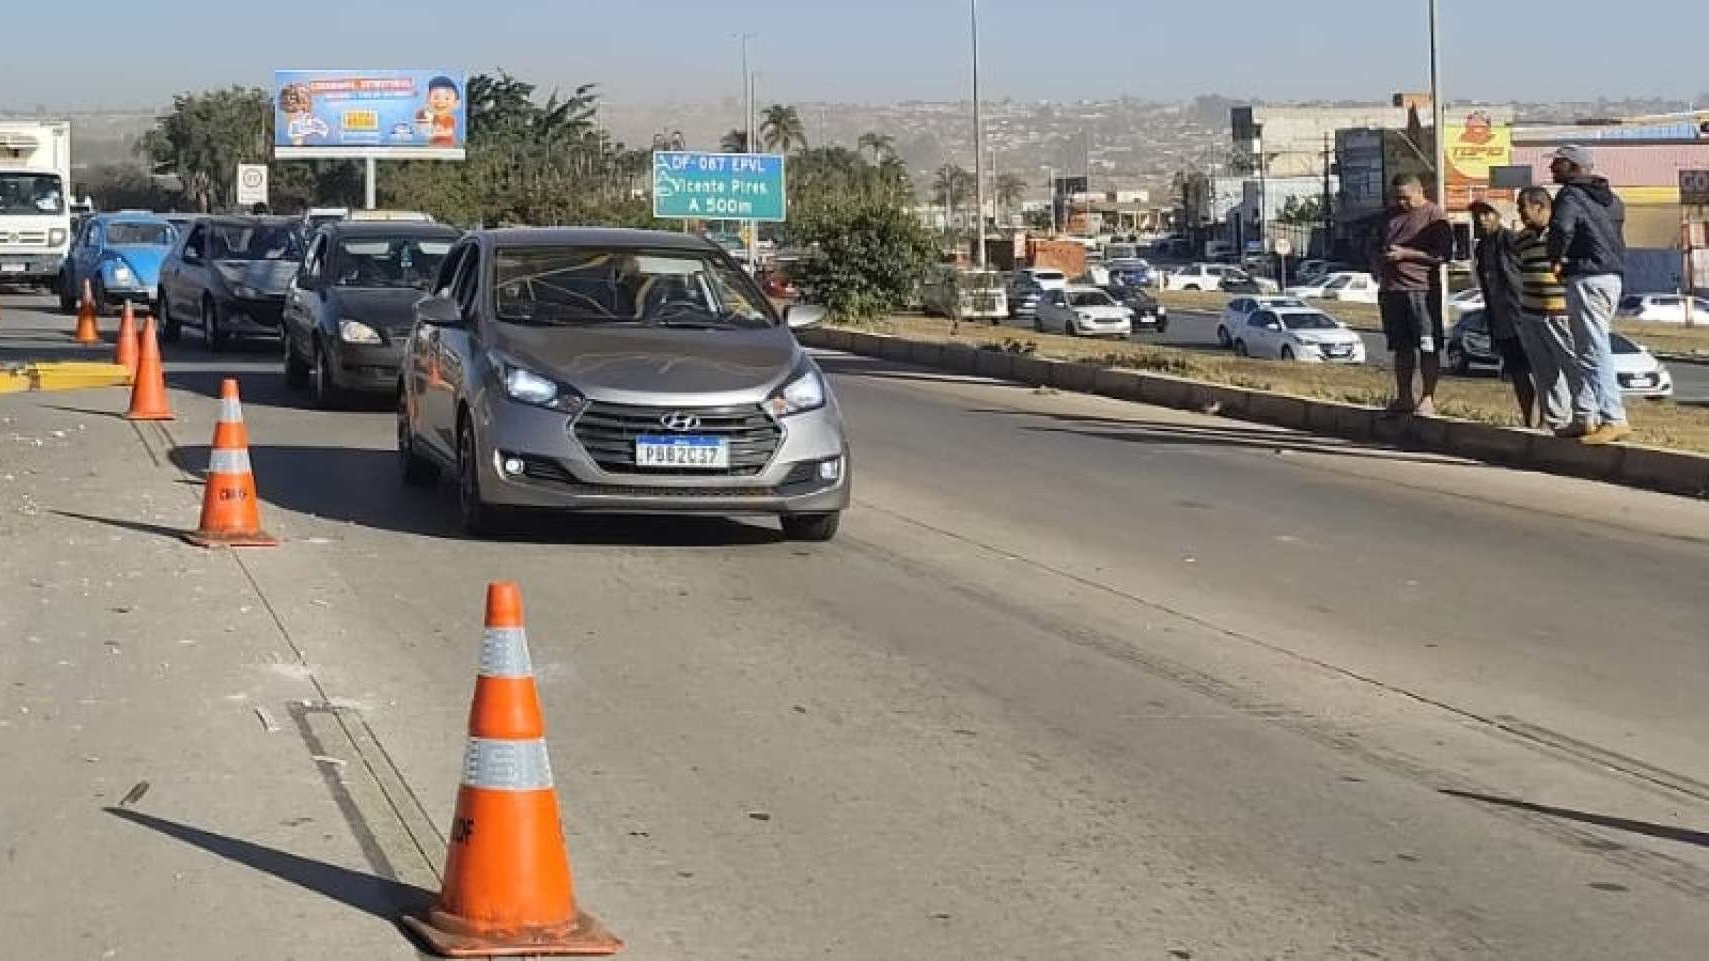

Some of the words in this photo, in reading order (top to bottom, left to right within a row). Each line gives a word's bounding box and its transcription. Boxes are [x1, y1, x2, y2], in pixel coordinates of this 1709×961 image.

[673, 179, 725, 194] Vicente
[732, 179, 769, 194] Pires
[688, 198, 699, 213] A
[706, 199, 753, 214] 500m
